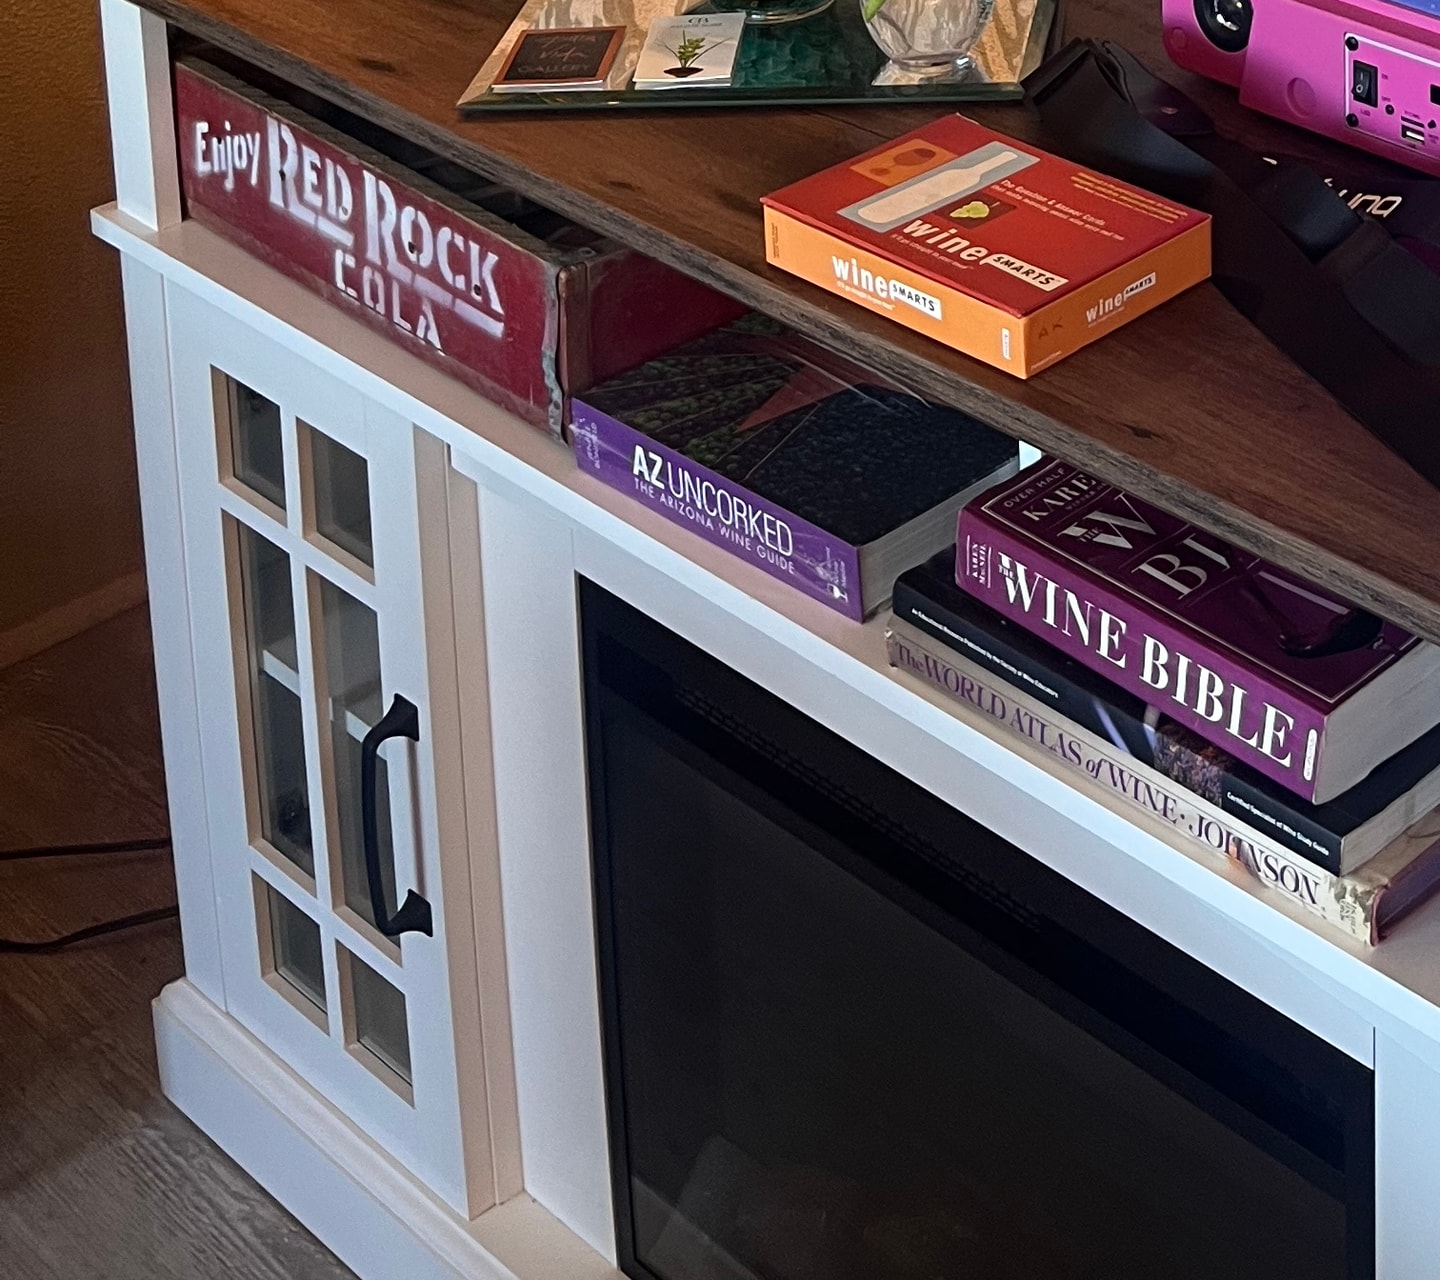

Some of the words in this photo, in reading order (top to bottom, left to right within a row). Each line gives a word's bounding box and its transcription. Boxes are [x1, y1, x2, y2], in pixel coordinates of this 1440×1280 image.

[196, 121, 260, 191] Enjoy
[267, 116, 354, 224] RED
[363, 169, 505, 316] ROCK
[903, 219, 989, 260] wine
[993, 255, 1055, 286] SMARTS
[334, 250, 443, 351] COLA
[832, 255, 888, 298] wine
[892, 283, 935, 312] SMARTS
[1086, 292, 1122, 323] wine
[633, 444, 665, 490] AZ
[667, 461, 793, 557] UNCORKED
[634, 477, 655, 499] THE
[659, 493, 714, 531] ARIZONA
[719, 523, 752, 551] WINE
[756, 545, 795, 575] GUIDE
[1004, 485, 1032, 508] OVER
[1035, 467, 1066, 488] HALF
[998, 564, 1015, 580] THE
[998, 551, 1128, 670] WINE
[1138, 633, 1295, 769] BIBLE
[895, 643, 923, 671] The
[923, 653, 1006, 721] WORLD
[1010, 707, 1082, 767] ATLAS
[1086, 757, 1106, 780] of
[1104, 760, 1177, 825] WINE
